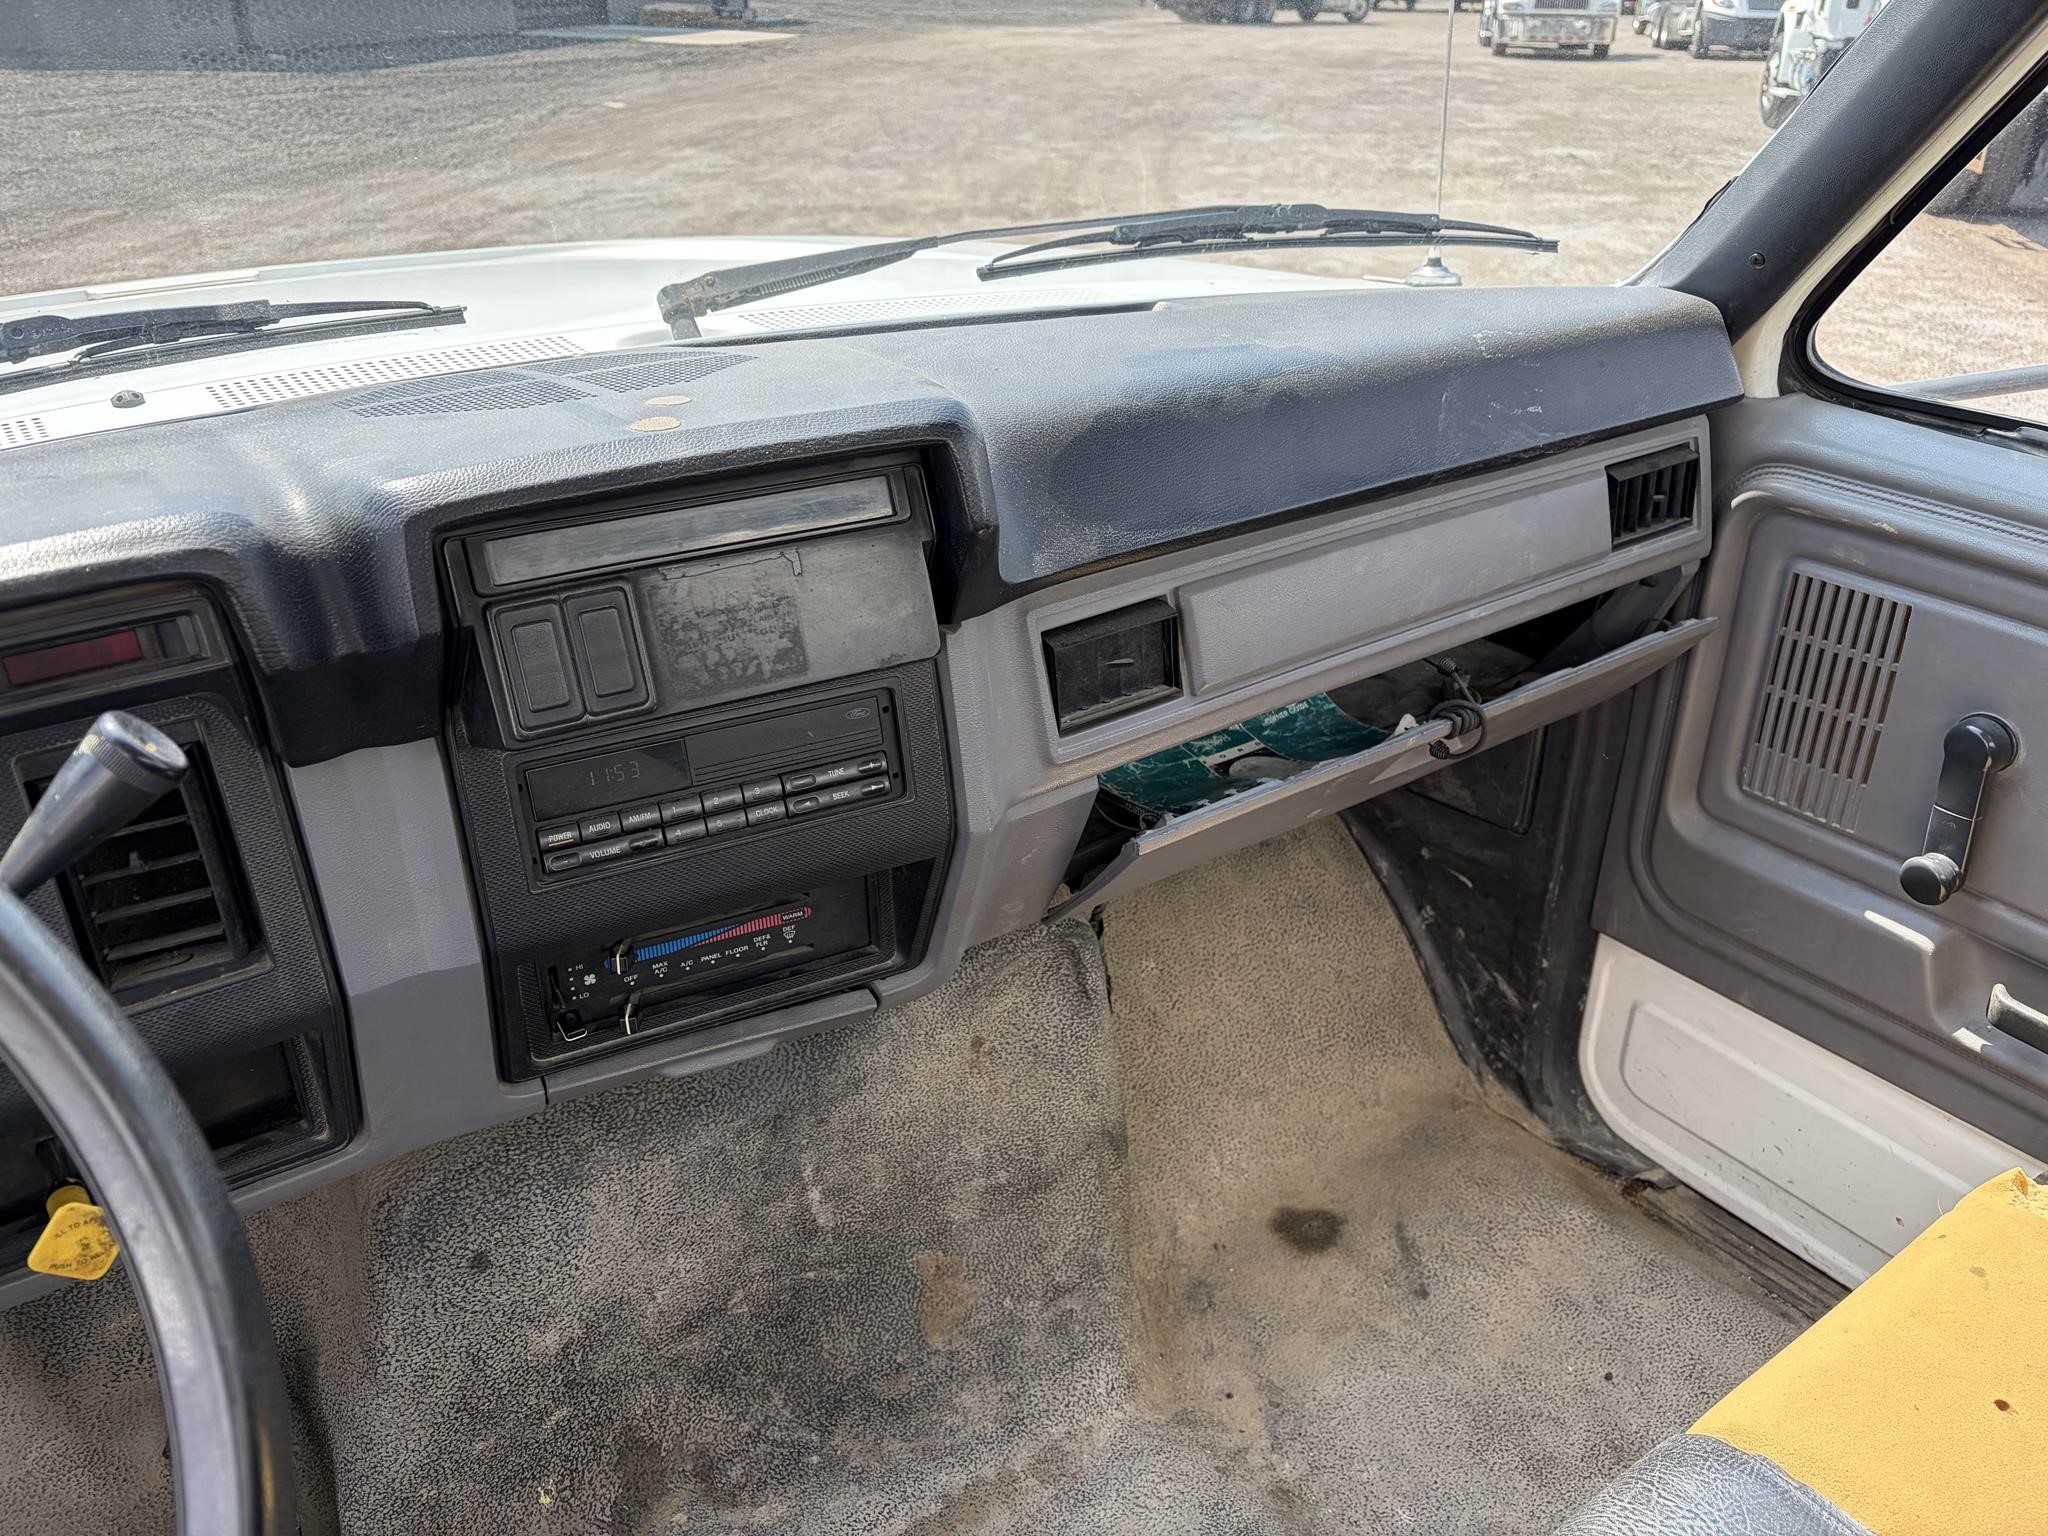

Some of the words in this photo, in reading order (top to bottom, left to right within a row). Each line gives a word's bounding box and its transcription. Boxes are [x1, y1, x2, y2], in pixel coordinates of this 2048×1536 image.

[589, 760, 640, 786] 11:53
[828, 767, 845, 777] TUNE
[754, 787, 760, 795] 3
[832, 790, 850, 800] SEEK
[713, 797, 719, 805] 2
[755, 806, 778, 817] CLOCK
[628, 812, 652, 823] AM/FM
[588, 821, 611, 833] AUDIO
[675, 828, 682, 836] 4
[548, 831, 572, 842] POWER
[589, 846, 621, 859] VOLUME
[782, 910, 803, 920] WARM
[753, 934, 771, 943] DEF&
[755, 939, 768, 948] FLR
[725, 945, 749, 955] FLOOR
[701, 952, 722, 962] PANEL
[652, 960, 668, 970] MAX
[680, 959, 694, 967] A/C
[654, 967, 668, 975] A/C
[623, 974, 638, 984] OFF
